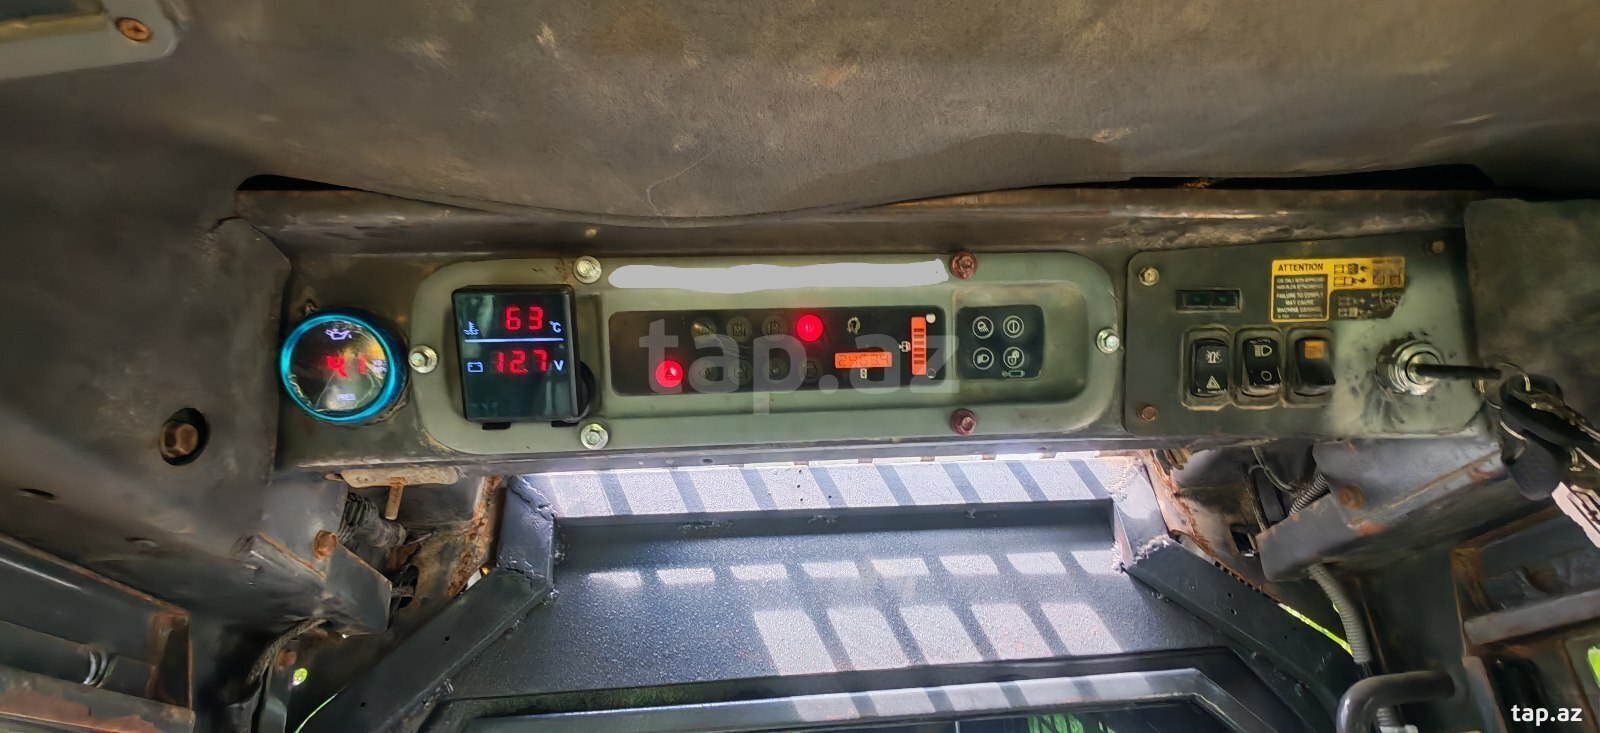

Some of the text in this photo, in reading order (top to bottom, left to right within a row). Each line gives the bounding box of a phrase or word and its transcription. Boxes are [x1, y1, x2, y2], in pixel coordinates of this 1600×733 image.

[1278, 263, 1324, 272] ATTENTION
[505, 306, 544, 331] 63
[554, 360, 564, 371] V
